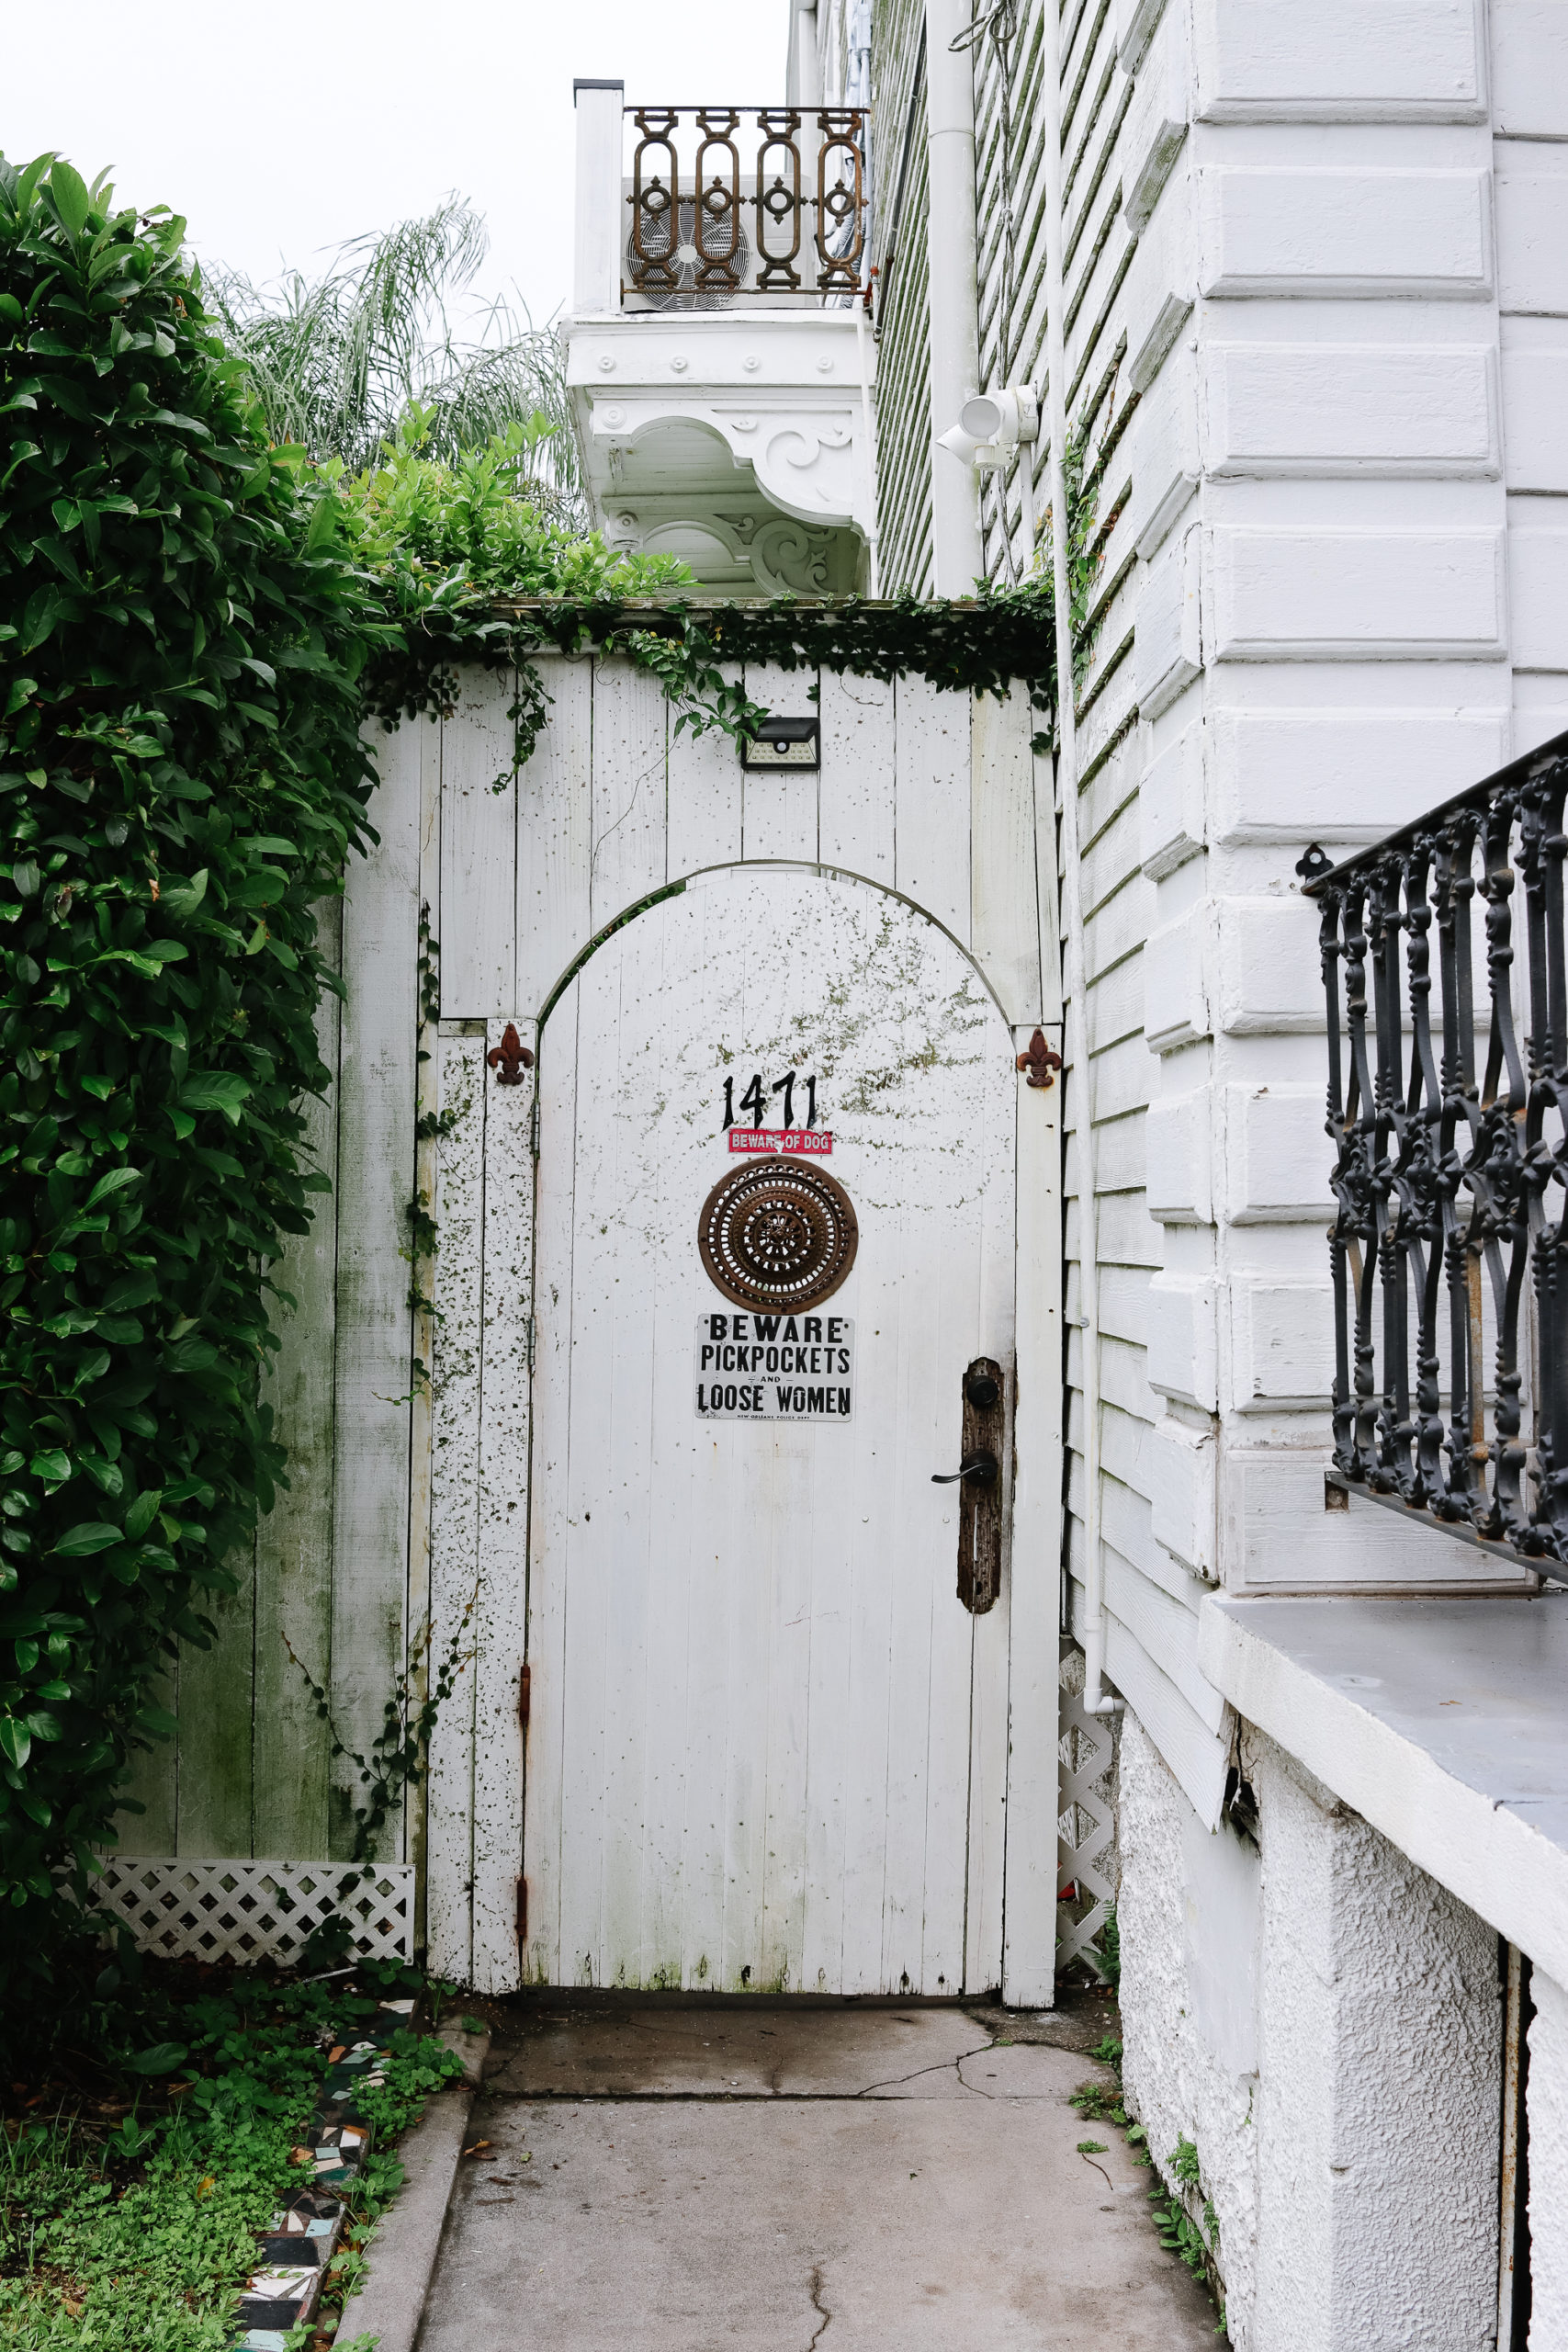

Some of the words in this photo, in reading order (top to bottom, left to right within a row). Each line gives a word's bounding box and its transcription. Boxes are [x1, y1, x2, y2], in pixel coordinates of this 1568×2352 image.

[721, 1070, 816, 1132] 1471
[784, 1135, 800, 1148] OF
[804, 1136, 829, 1149] DOG
[710, 1314, 843, 1343] BEWARE
[701, 1345, 850, 1374] PICKPOCKETS
[698, 1384, 763, 1412] LOOSE
[776, 1385, 851, 1414] WOMEN
